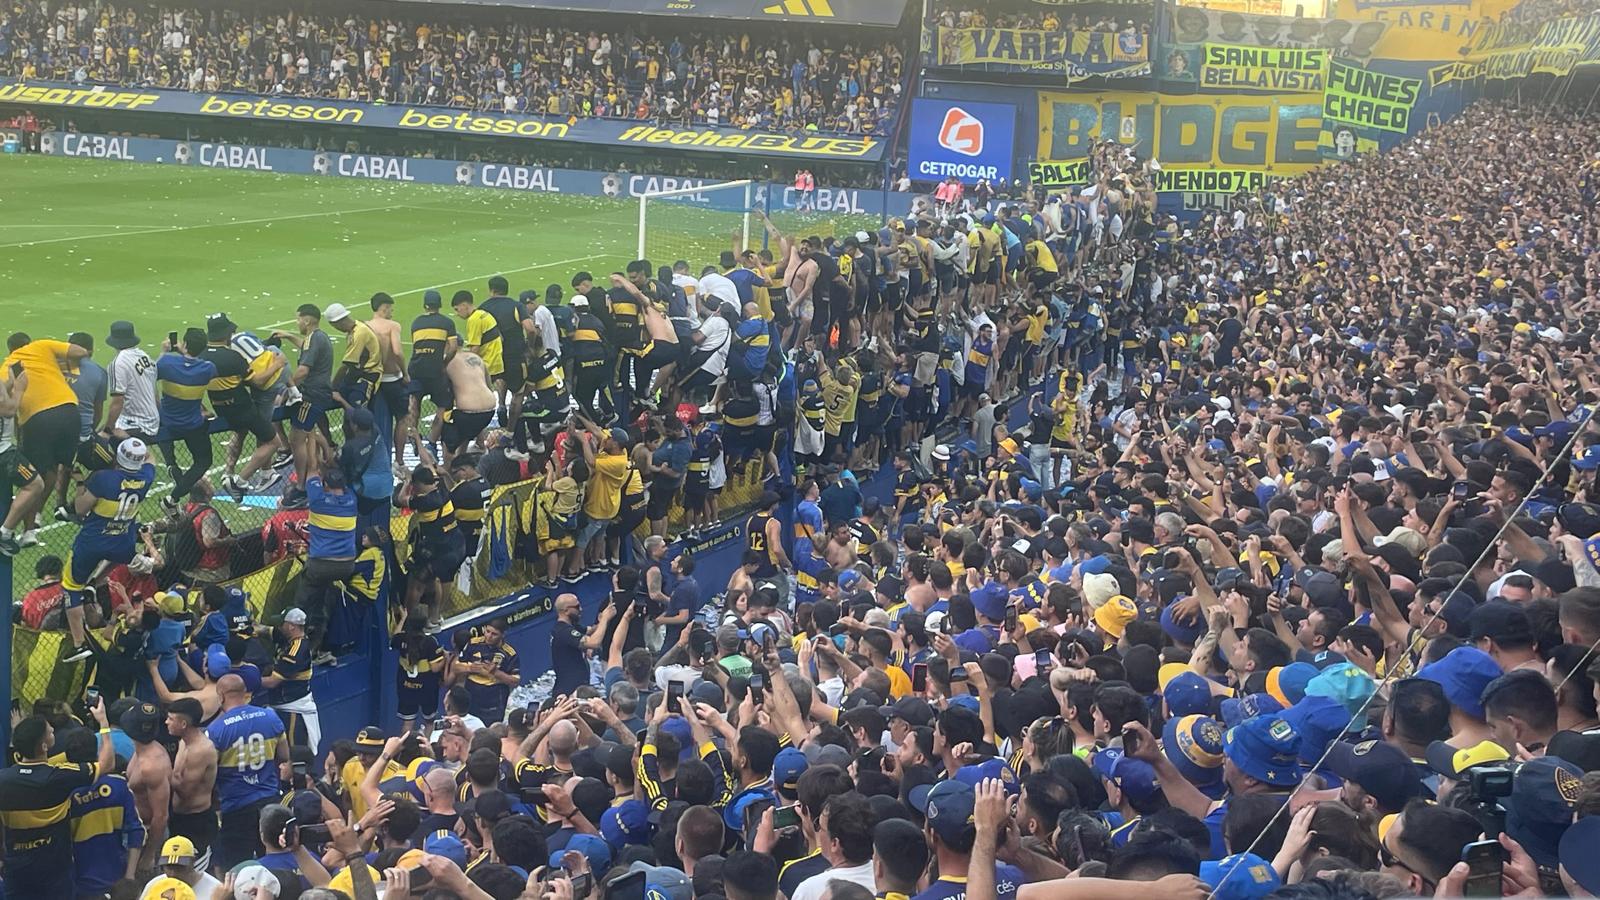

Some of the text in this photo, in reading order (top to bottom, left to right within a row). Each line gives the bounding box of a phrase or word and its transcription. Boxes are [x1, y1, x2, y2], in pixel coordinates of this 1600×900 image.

[973, 31, 1108, 62] VARELA
[1328, 62, 1420, 105] FUNES
[199, 95, 364, 123] betsson
[1325, 94, 1407, 129] CHACO
[399, 109, 569, 138] betsson
[1051, 101, 1324, 165] BUDGE
[63, 134, 135, 160] CABAL
[199, 143, 273, 170] CABAL
[338, 154, 415, 181] CABAL
[481, 164, 560, 192] CABAL
[920, 160, 998, 180] CETROGAR
[1030, 161, 1090, 185] SALTA
[1158, 171, 1263, 191] MENDOZA
[629, 175, 710, 202] CABAL
[114, 491, 140, 521] 10
[750, 532, 764, 551] 12
[232, 733, 266, 773] 19
